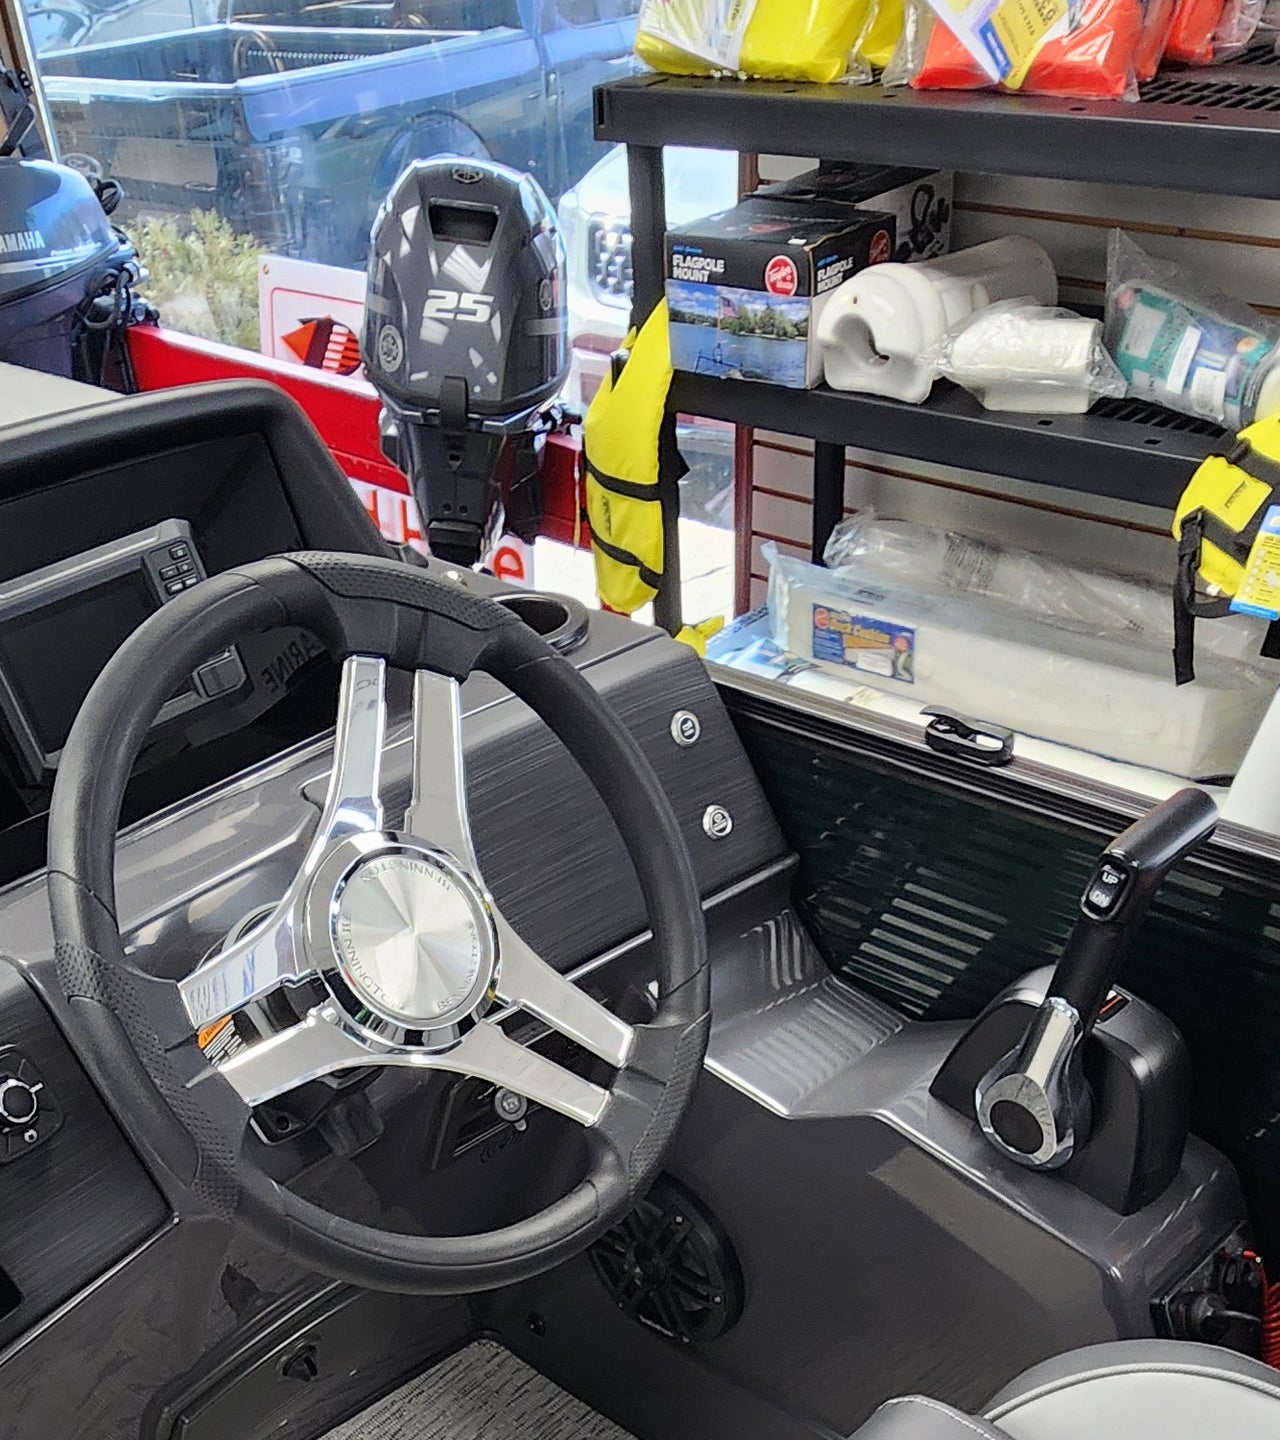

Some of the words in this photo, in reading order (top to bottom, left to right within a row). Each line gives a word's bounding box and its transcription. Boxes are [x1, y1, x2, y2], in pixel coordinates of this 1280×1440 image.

[672, 254, 725, 273] FLAGPOLE
[672, 267, 710, 283] MOUNT
[422, 289, 495, 323] 25
[1101, 871, 1119, 885] UP
